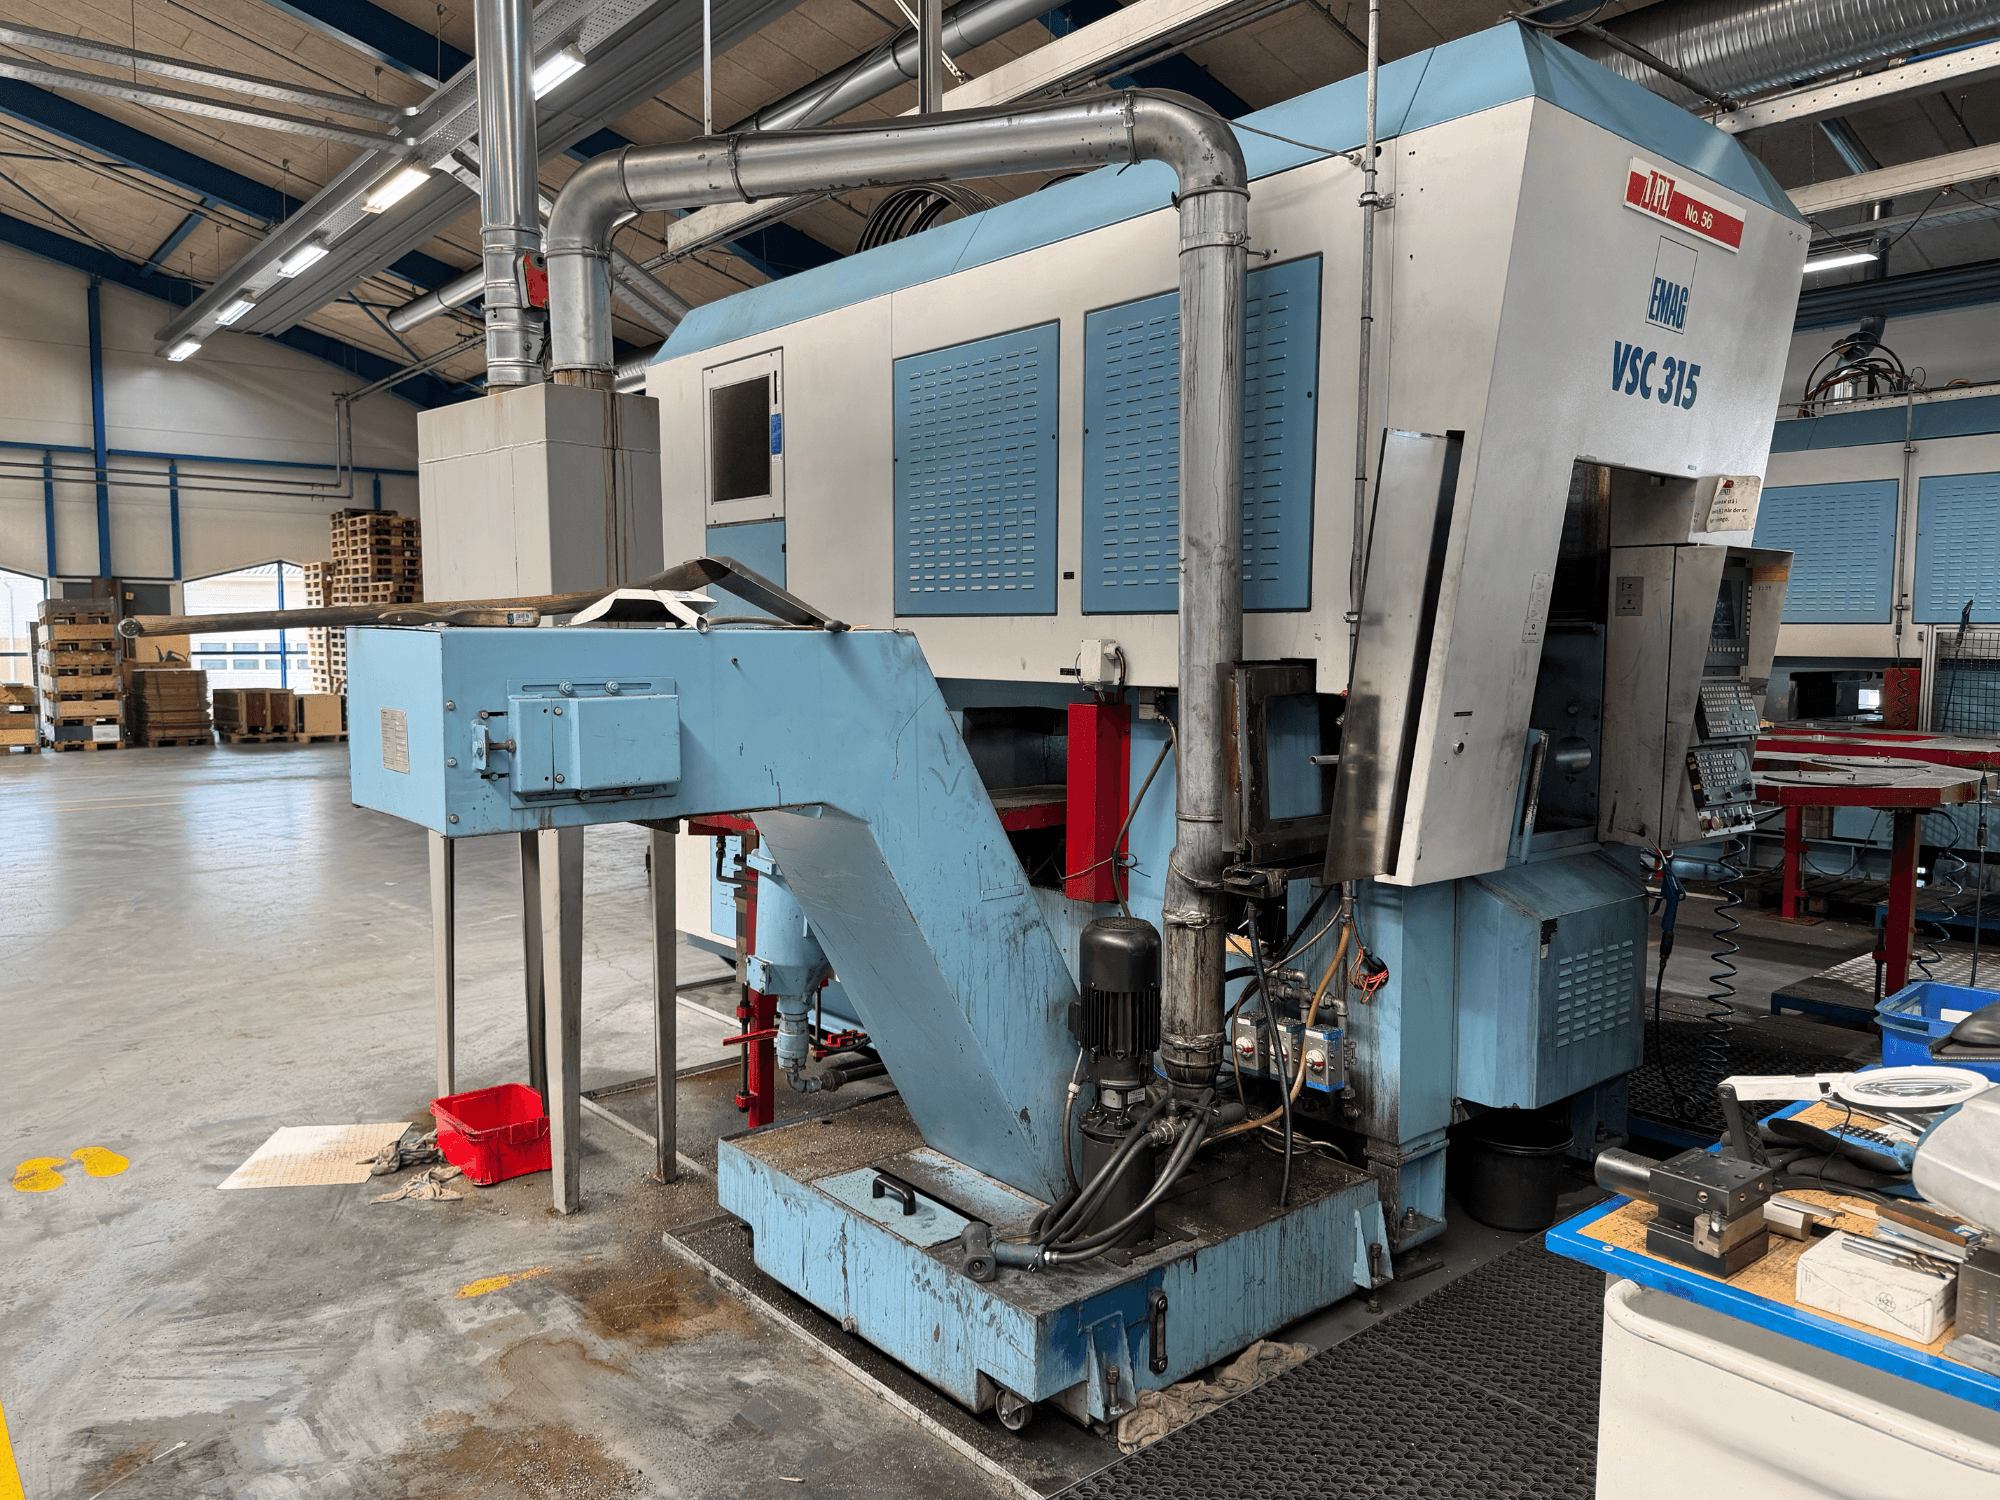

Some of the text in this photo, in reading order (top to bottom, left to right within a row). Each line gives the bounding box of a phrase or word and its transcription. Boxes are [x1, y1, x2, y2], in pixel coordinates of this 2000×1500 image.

[1685, 203, 1699, 224] No.
[1700, 210, 1714, 230] 56
[1648, 277, 1688, 330] EMAG
[1611, 340, 1702, 410] VSC 315
